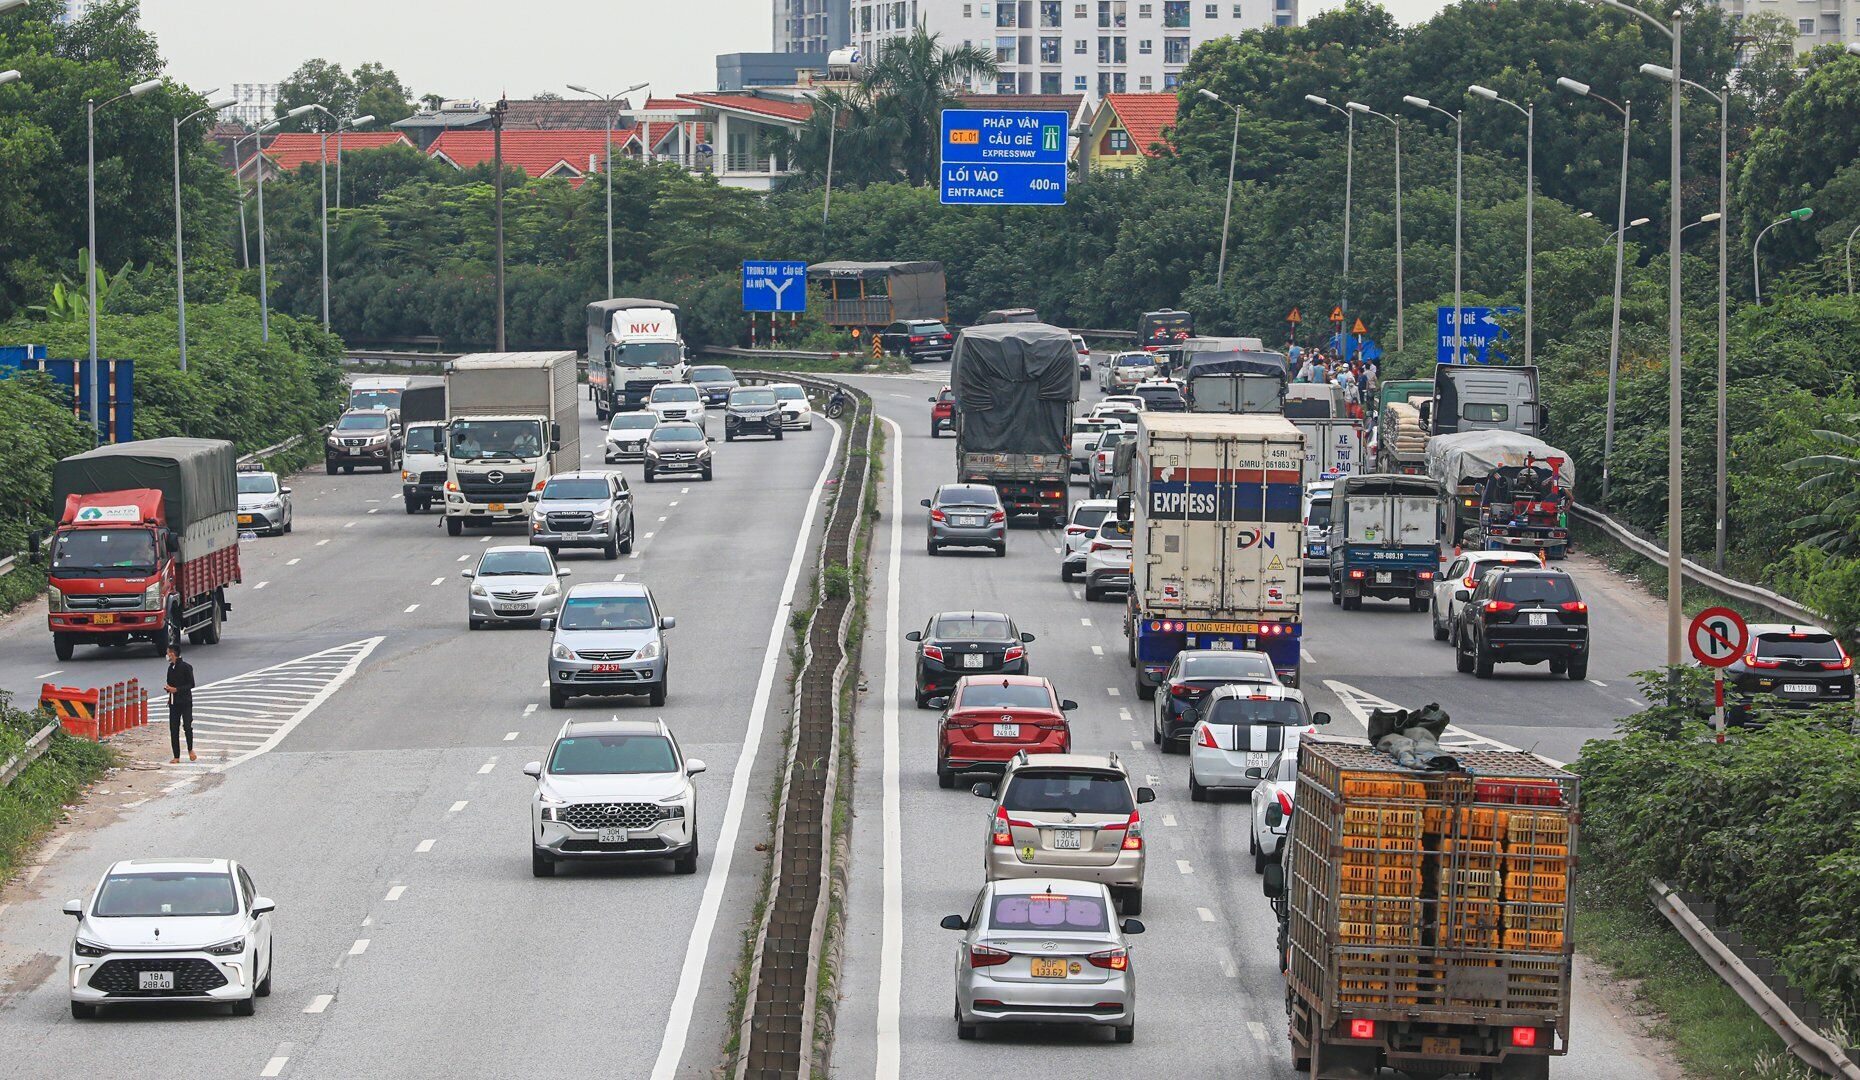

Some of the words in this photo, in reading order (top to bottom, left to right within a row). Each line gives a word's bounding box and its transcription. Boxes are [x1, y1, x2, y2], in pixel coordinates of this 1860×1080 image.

[983, 116, 1013, 128] PHÁP
[1018, 116, 1039, 128] VÂN
[982, 150, 1036, 158] EXPRESSWAY
[948, 166, 969, 182] LỐI
[974, 167, 998, 182] VÀO
[1029, 179, 1060, 190] 400m
[948, 188, 1004, 198] ENTRANCE
[630, 324, 660, 334] NKV
[1339, 435, 1348, 444] XE
[1337, 450, 1350, 460] THƯ
[1154, 492, 1214, 514] EXPRESS
[1190, 622, 1212, 631] LONG
[1215, 623, 1252, 632] VEHICLE
[1061, 831, 1075, 839] 30E
